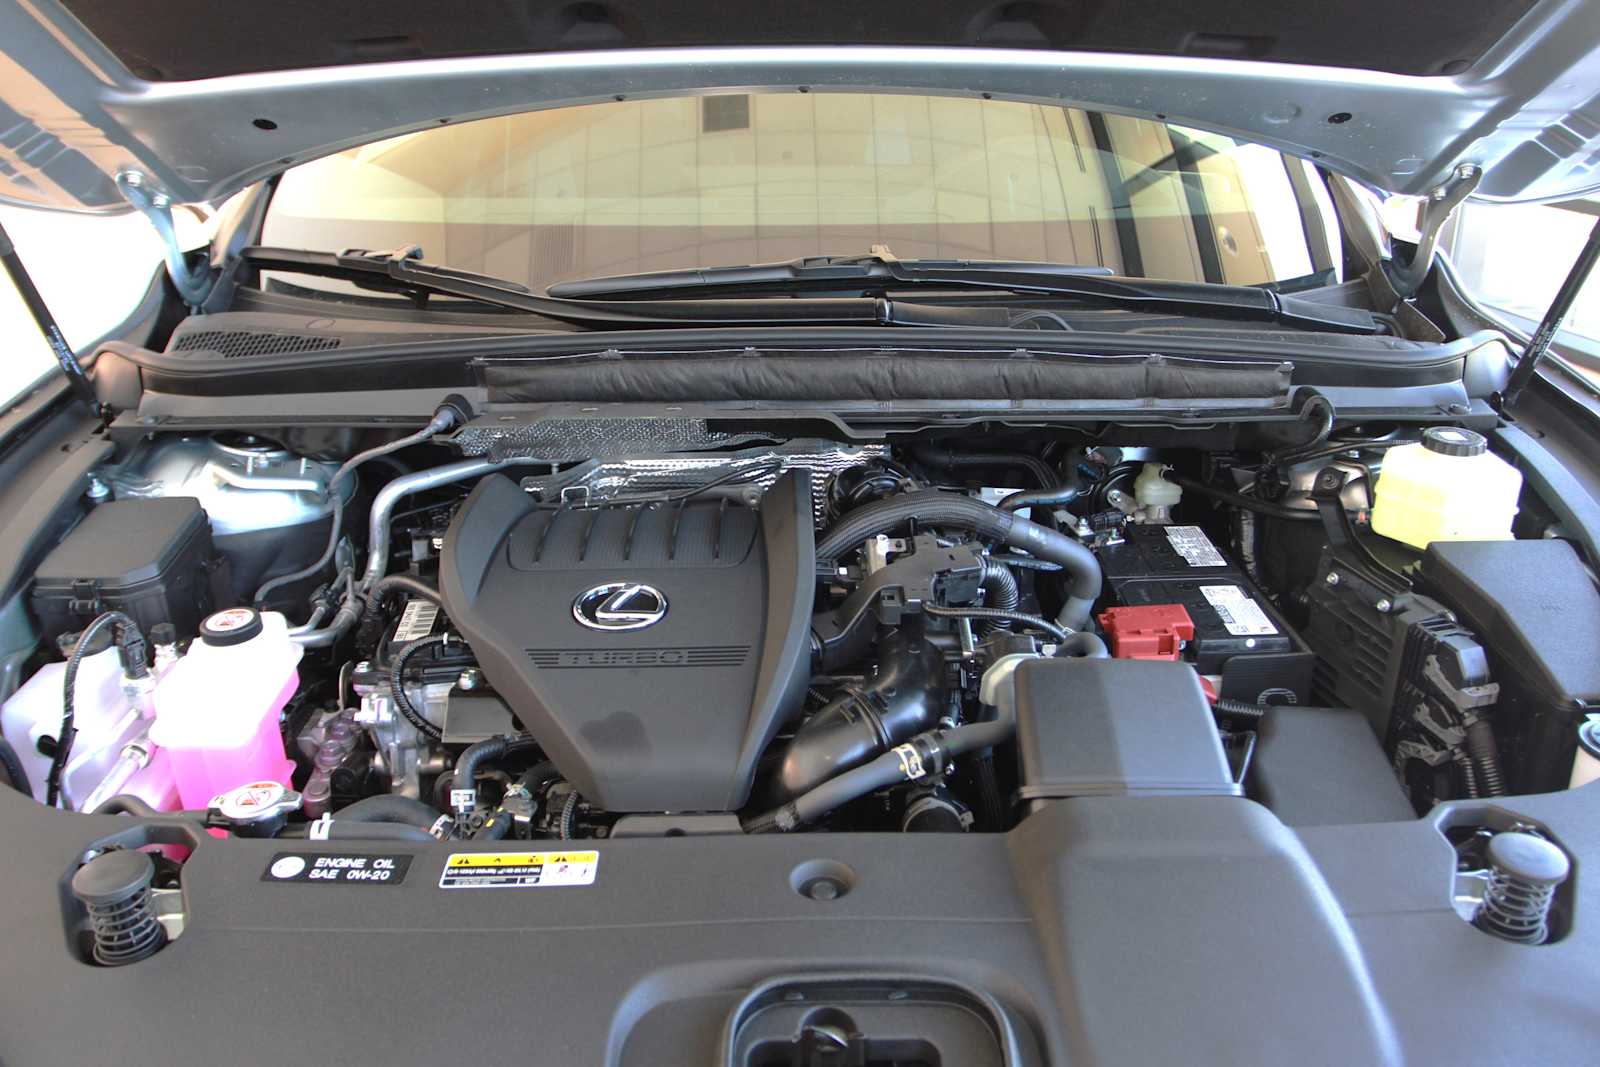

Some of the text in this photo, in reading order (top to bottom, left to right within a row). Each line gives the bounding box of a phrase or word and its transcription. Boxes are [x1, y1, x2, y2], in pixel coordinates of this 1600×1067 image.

[565, 650, 683, 664] TURBO
[313, 857, 395, 869] ENGINE OIL
[308, 869, 390, 881] SAE 0W-20
